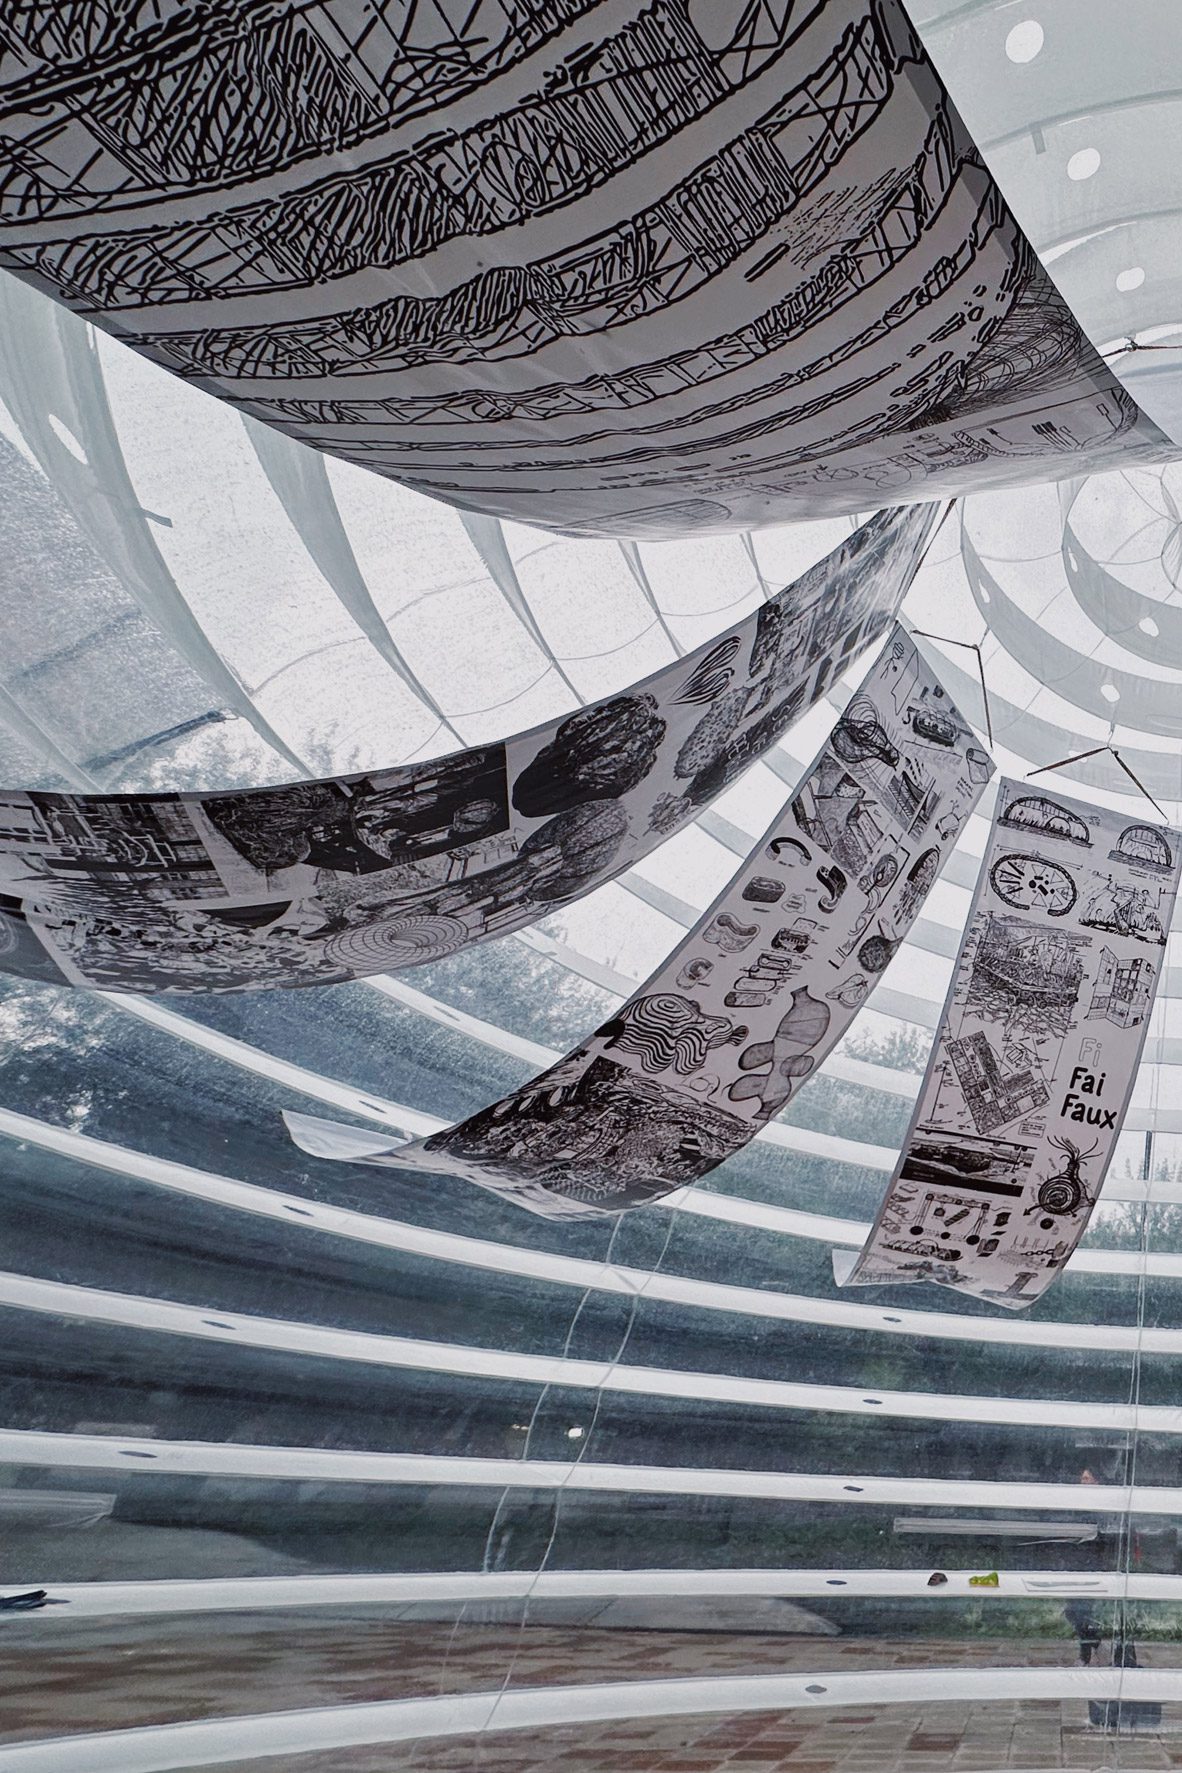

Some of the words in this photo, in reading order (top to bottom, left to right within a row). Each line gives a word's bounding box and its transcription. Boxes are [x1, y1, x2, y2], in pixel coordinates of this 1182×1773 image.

[1079, 1037, 1103, 1067] Fi
[1070, 1066, 1106, 1097] Fai
[1060, 1093, 1118, 1130] Faux
